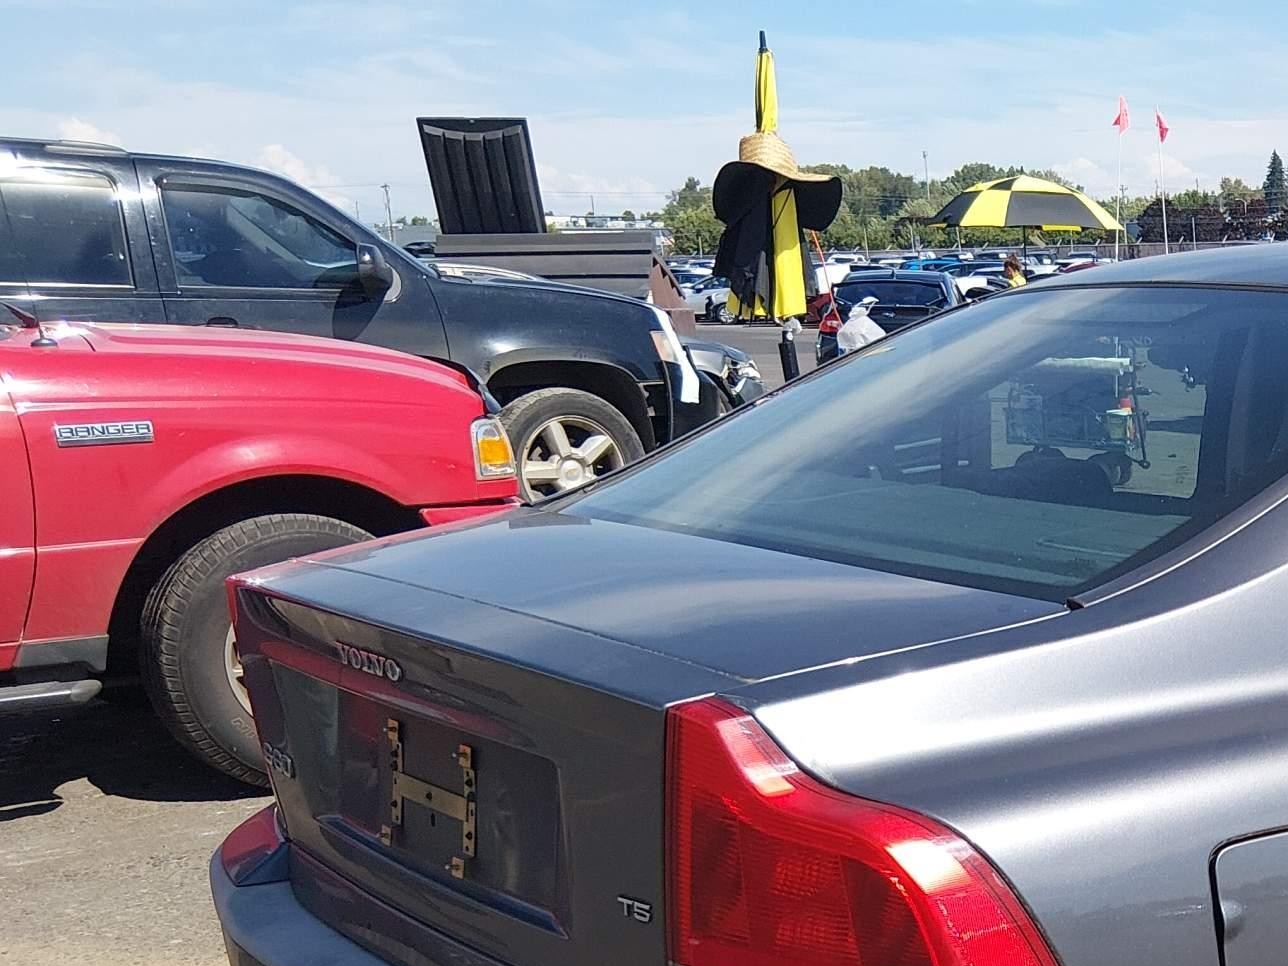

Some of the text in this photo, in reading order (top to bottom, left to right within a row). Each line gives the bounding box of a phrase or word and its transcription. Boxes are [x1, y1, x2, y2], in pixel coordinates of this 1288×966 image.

[57, 422, 152, 439] RANGER
[335, 641, 401, 682] VOLVO
[616, 896, 651, 922] T5
